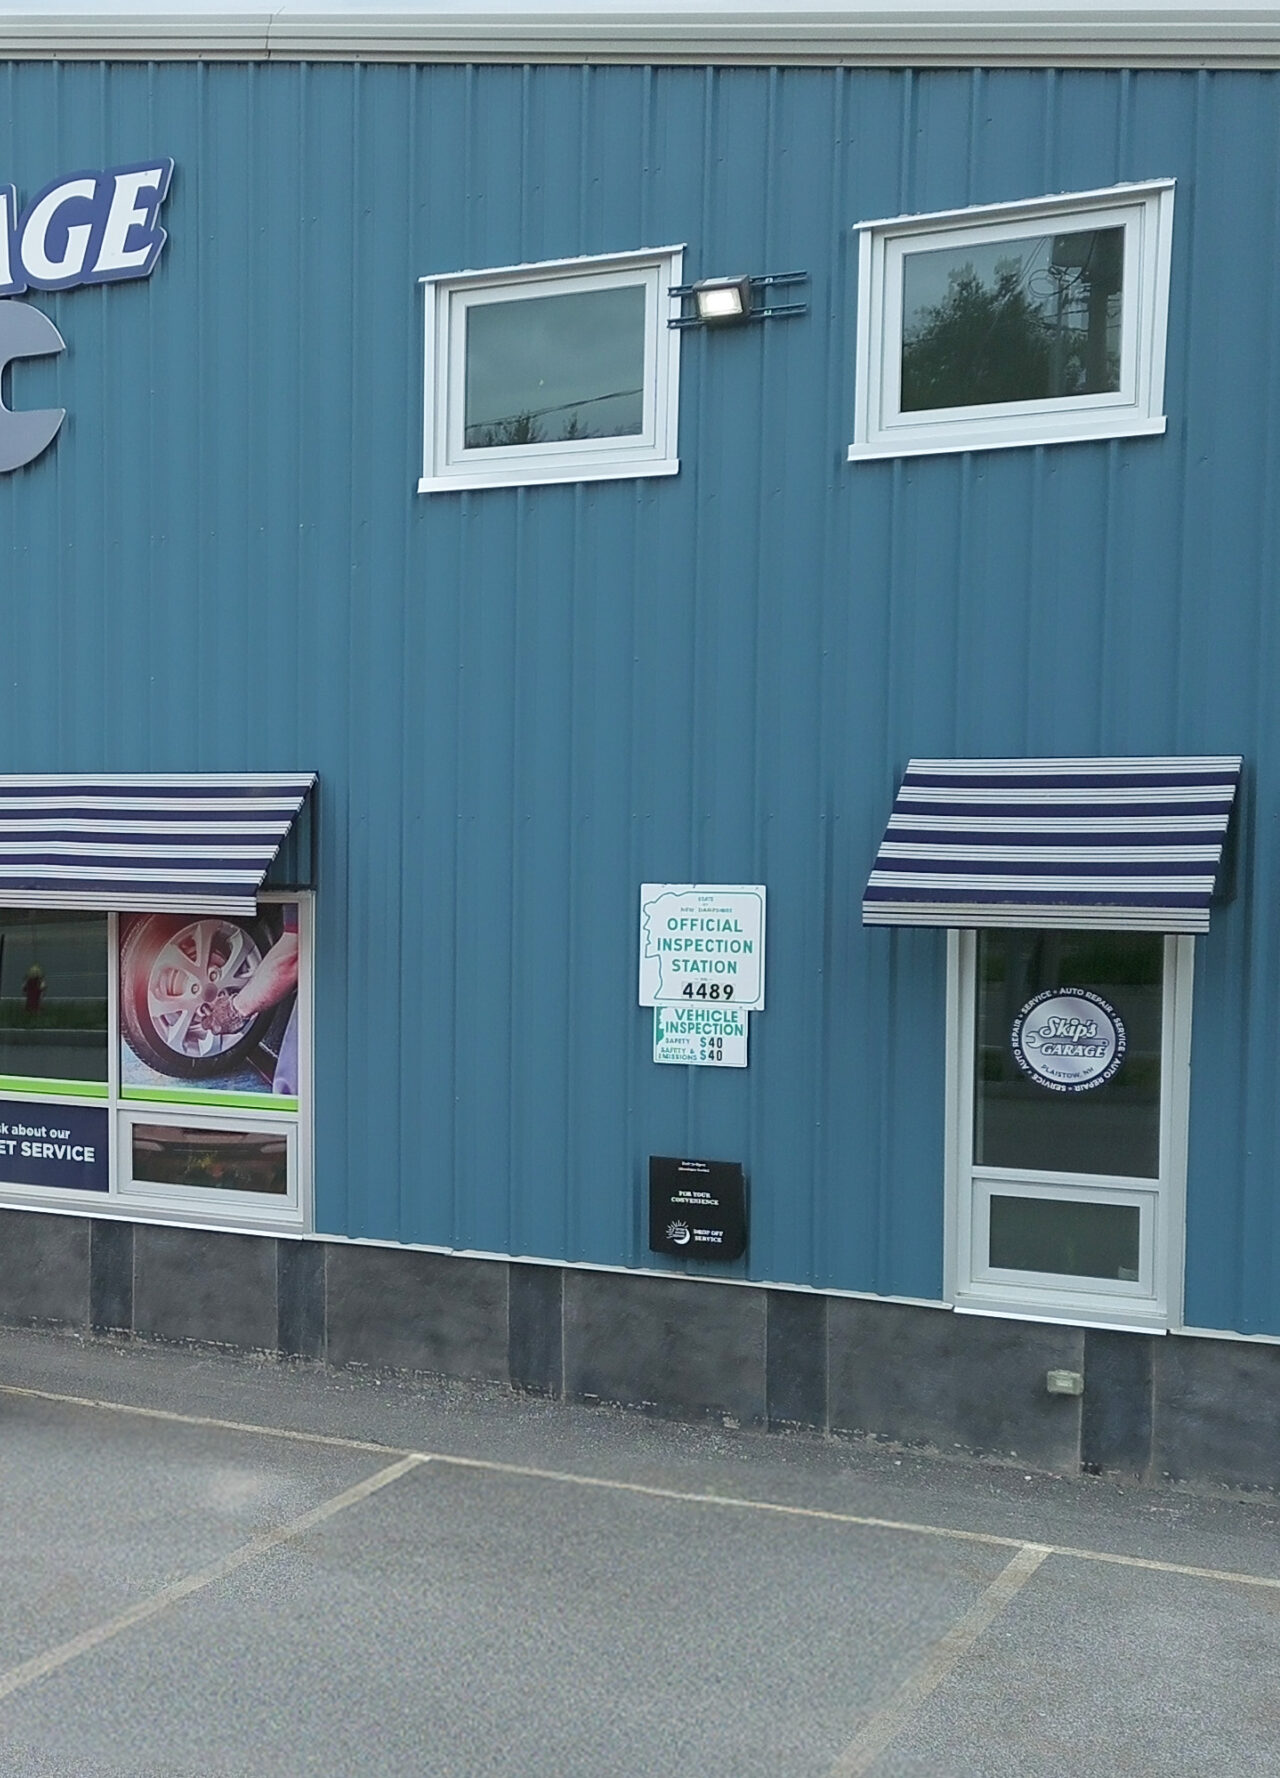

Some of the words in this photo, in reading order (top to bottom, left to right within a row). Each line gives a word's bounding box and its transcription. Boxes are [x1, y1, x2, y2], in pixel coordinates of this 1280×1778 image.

[667, 918, 743, 933] OFFICIAL
[657, 937, 753, 954] INSPECTION
[672, 959, 737, 974] STATION
[682, 982, 734, 1000] 4489
[675, 1008, 738, 1023] VEHICLE
[1021, 990, 1052, 1014] SERVICE
[1059, 987, 1084, 996] AUTO
[1085, 991, 1114, 1013] REPAIR
[1113, 1017, 1127, 1052] SERVICE
[665, 1021, 744, 1036] INSPECTION
[1039, 1016, 1098, 1042] Skip's
[1040, 1043, 1106, 1058] GARAGE
[11, 1123, 47, 1138] about
[50, 1128, 70, 1139] our
[21, 1144, 95, 1162] SERVICE
